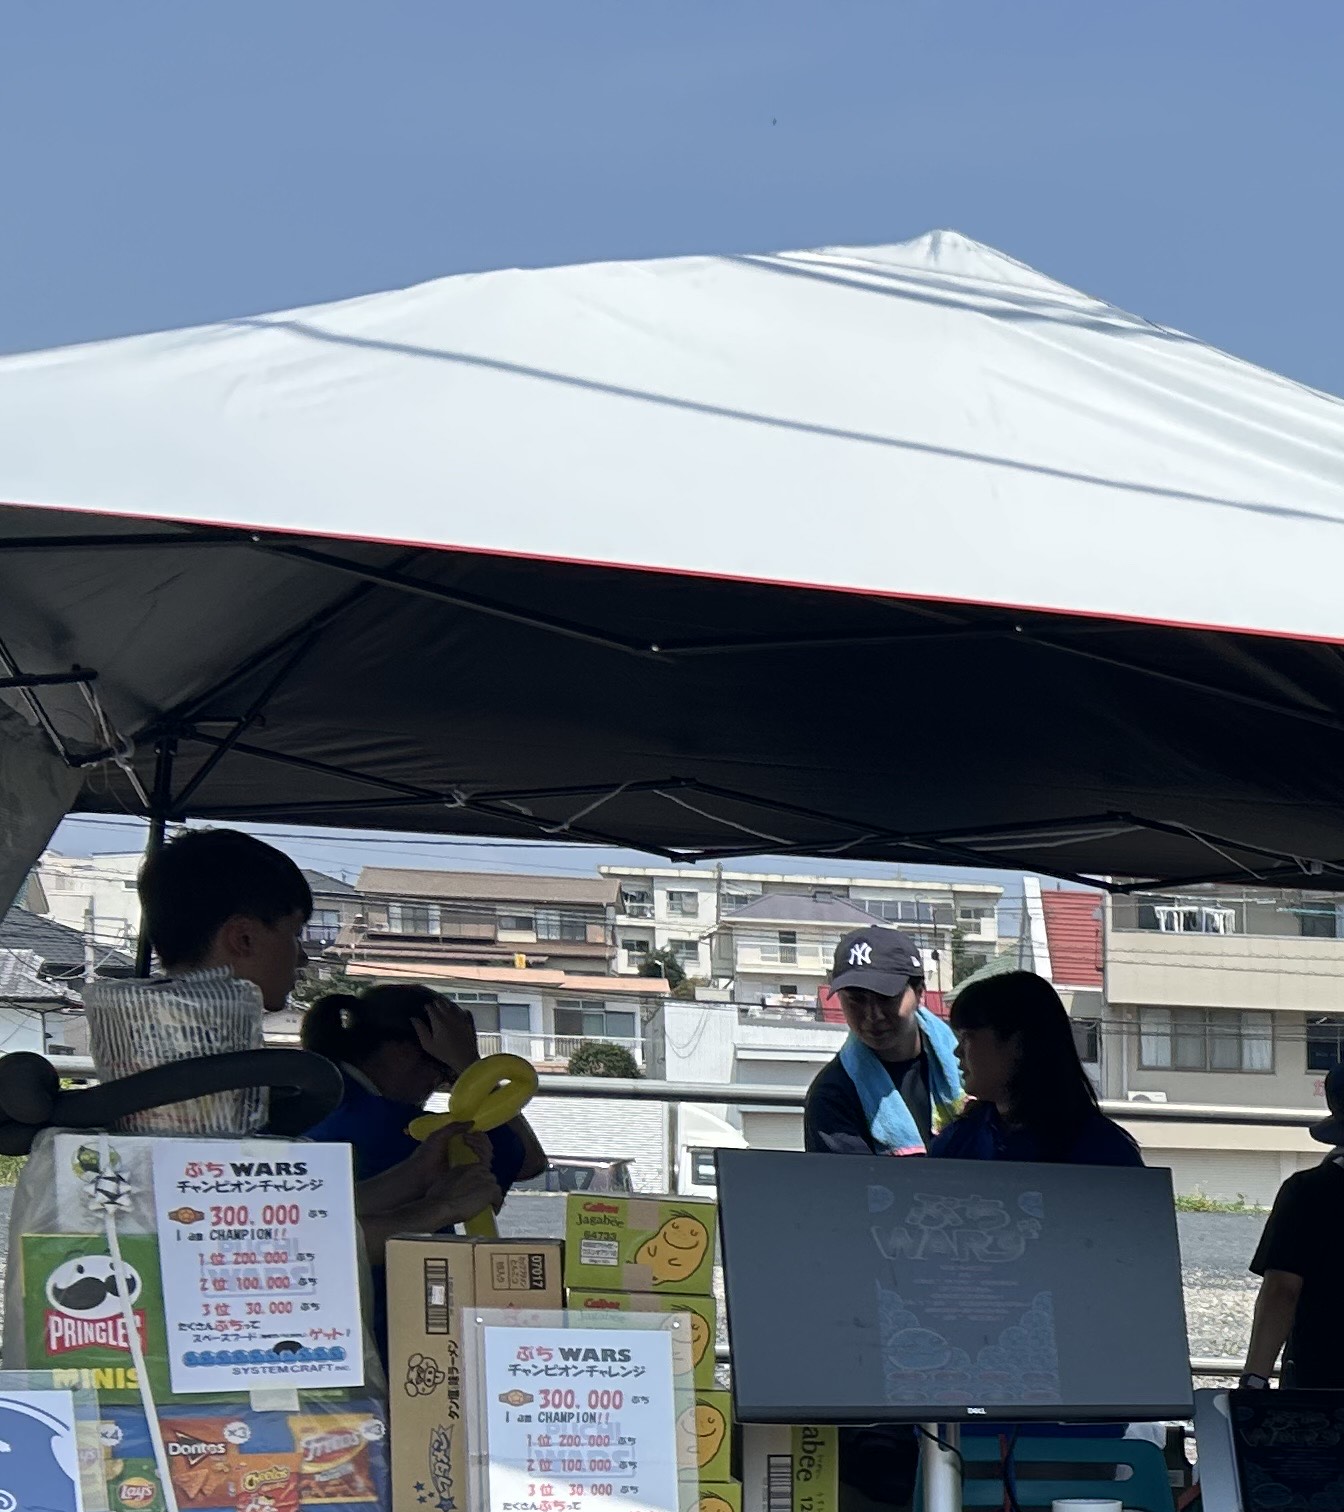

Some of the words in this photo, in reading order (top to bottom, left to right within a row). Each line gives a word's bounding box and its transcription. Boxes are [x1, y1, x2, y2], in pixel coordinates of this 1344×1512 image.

[229, 1161, 309, 1177] WARS
[176, 1178, 324, 1194] チャンピオンチャレンジ
[209, 1204, 301, 1226] 300.000
[576, 1213, 625, 1229] Jagabee
[187, 1232, 204, 1242] am
[209, 1227, 288, 1242] CHAMPION!!
[531, 1255, 544, 1288] 07017
[49, 1315, 142, 1351] PRINGLE
[559, 1347, 632, 1362] WARS
[507, 1363, 646, 1378] チャンピオンチャレンジ
[539, 1389, 624, 1410] 300.000
[517, 1414, 532, 1423] am
[538, 1410, 610, 1424] CHAMPION!!
[168, 1443, 227, 1456] Doritos
[120, 1484, 153, 1500] Lay's
